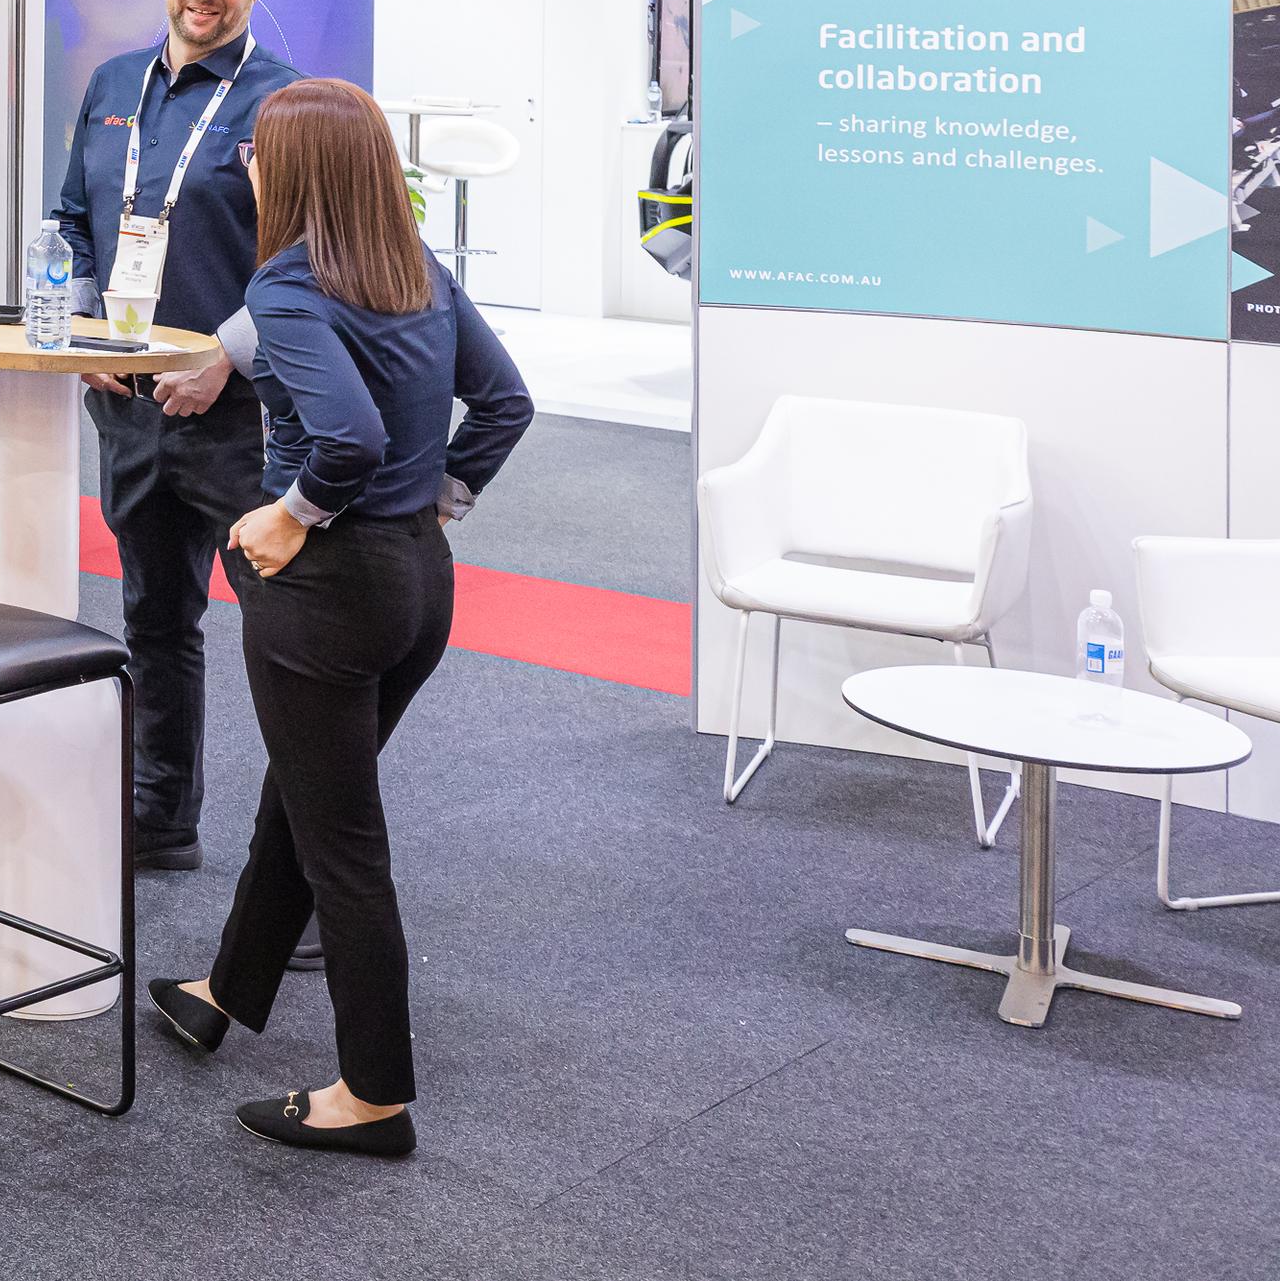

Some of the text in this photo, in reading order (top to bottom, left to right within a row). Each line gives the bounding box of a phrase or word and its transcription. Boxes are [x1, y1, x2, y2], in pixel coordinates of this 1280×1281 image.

[819, 23, 1086, 53] Facilitation and
[818, 64, 1042, 94] collaboration
[104, 115, 127, 126] afac
[839, 114, 927, 139] sharing
[935, 116, 1078, 144] knowledge,
[818, 143, 1104, 176] lessons and challenges.
[729, 268, 882, 286] WWW.AFAC.COM.AU
